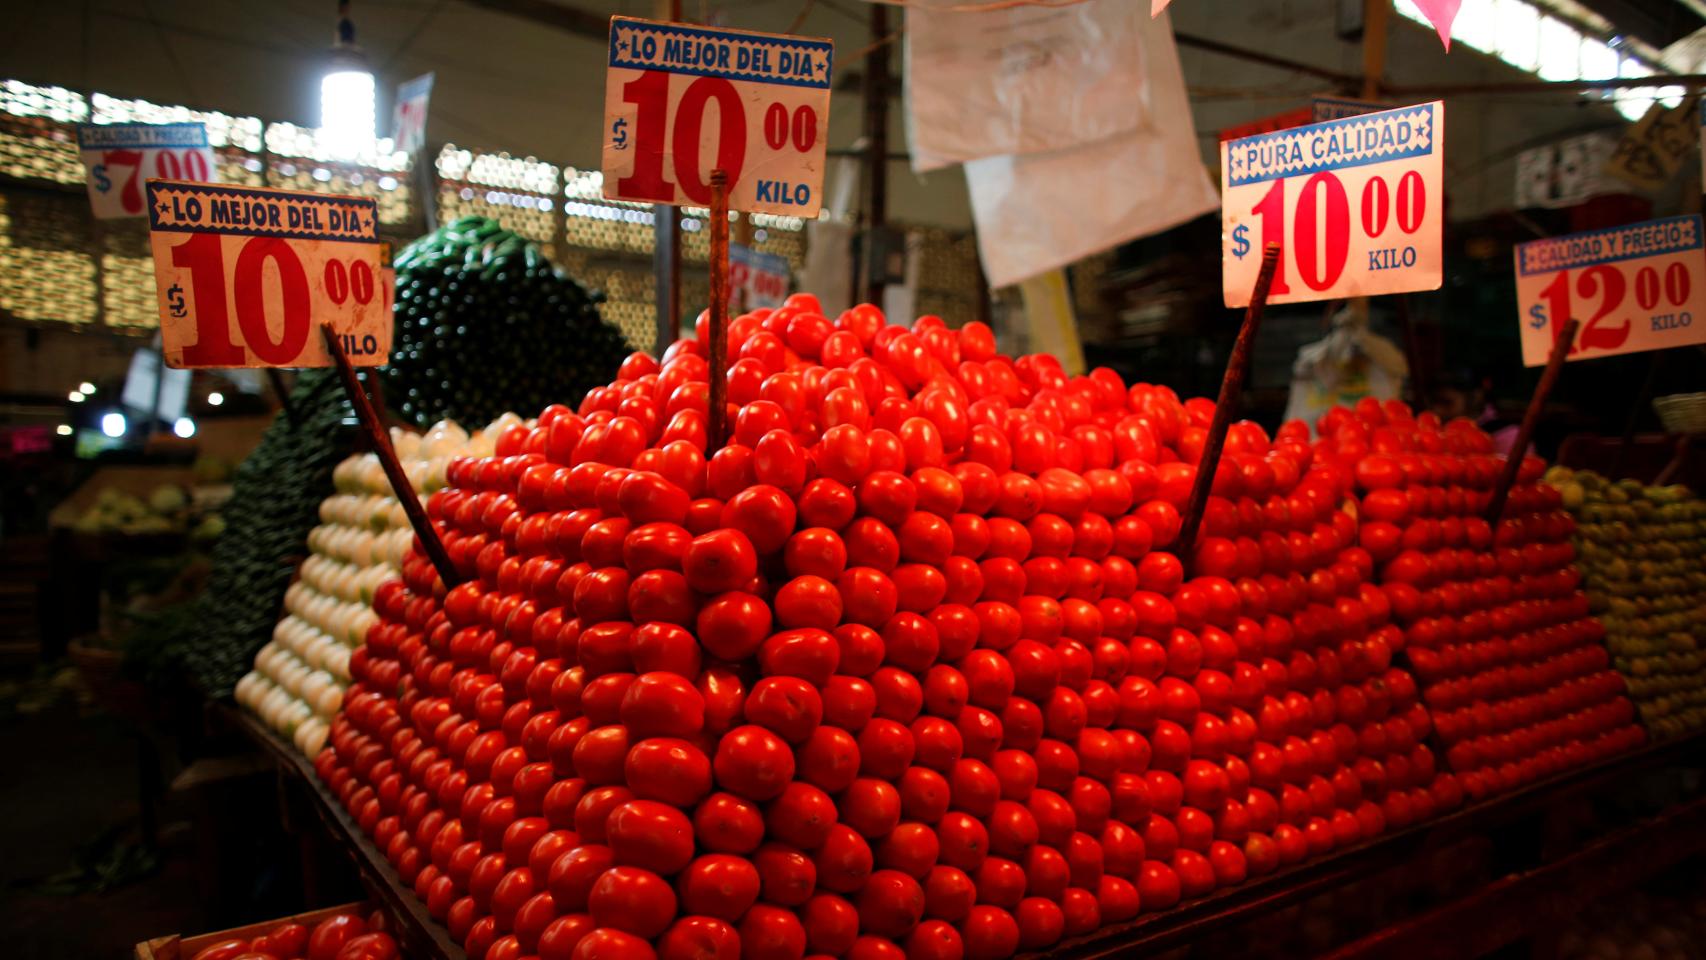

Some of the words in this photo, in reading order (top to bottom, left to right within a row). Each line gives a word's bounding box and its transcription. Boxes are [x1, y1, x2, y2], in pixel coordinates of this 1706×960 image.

[630, 34, 657, 60] LO
[663, 38, 730, 69] MEJOR
[736, 46, 772, 73] DEL
[778, 51, 814, 77] DIA
[612, 118, 628, 150] $
[763, 102, 817, 153] 00
[1247, 141, 1303, 169] PURA
[1310, 121, 1412, 160] CALIDAD
[756, 179, 811, 206] KILO
[172, 196, 201, 222] LO
[211, 200, 283, 229] MEJOR
[287, 205, 323, 231] DEL
[329, 208, 363, 233] DIA
[1231, 223, 1250, 260] $
[1361, 170, 1426, 239] 00
[1368, 246, 1417, 271] KILO
[1538, 239, 1601, 266] CALIDAD
[1606, 237, 1619, 254] Y
[1621, 226, 1683, 252] PRECIO
[167, 283, 188, 318] $
[171, 232, 311, 366] 10
[324, 258, 374, 305] 00
[1528, 303, 1548, 330] $
[1634, 261, 1691, 311] 00
[1650, 311, 1693, 332] KILO
